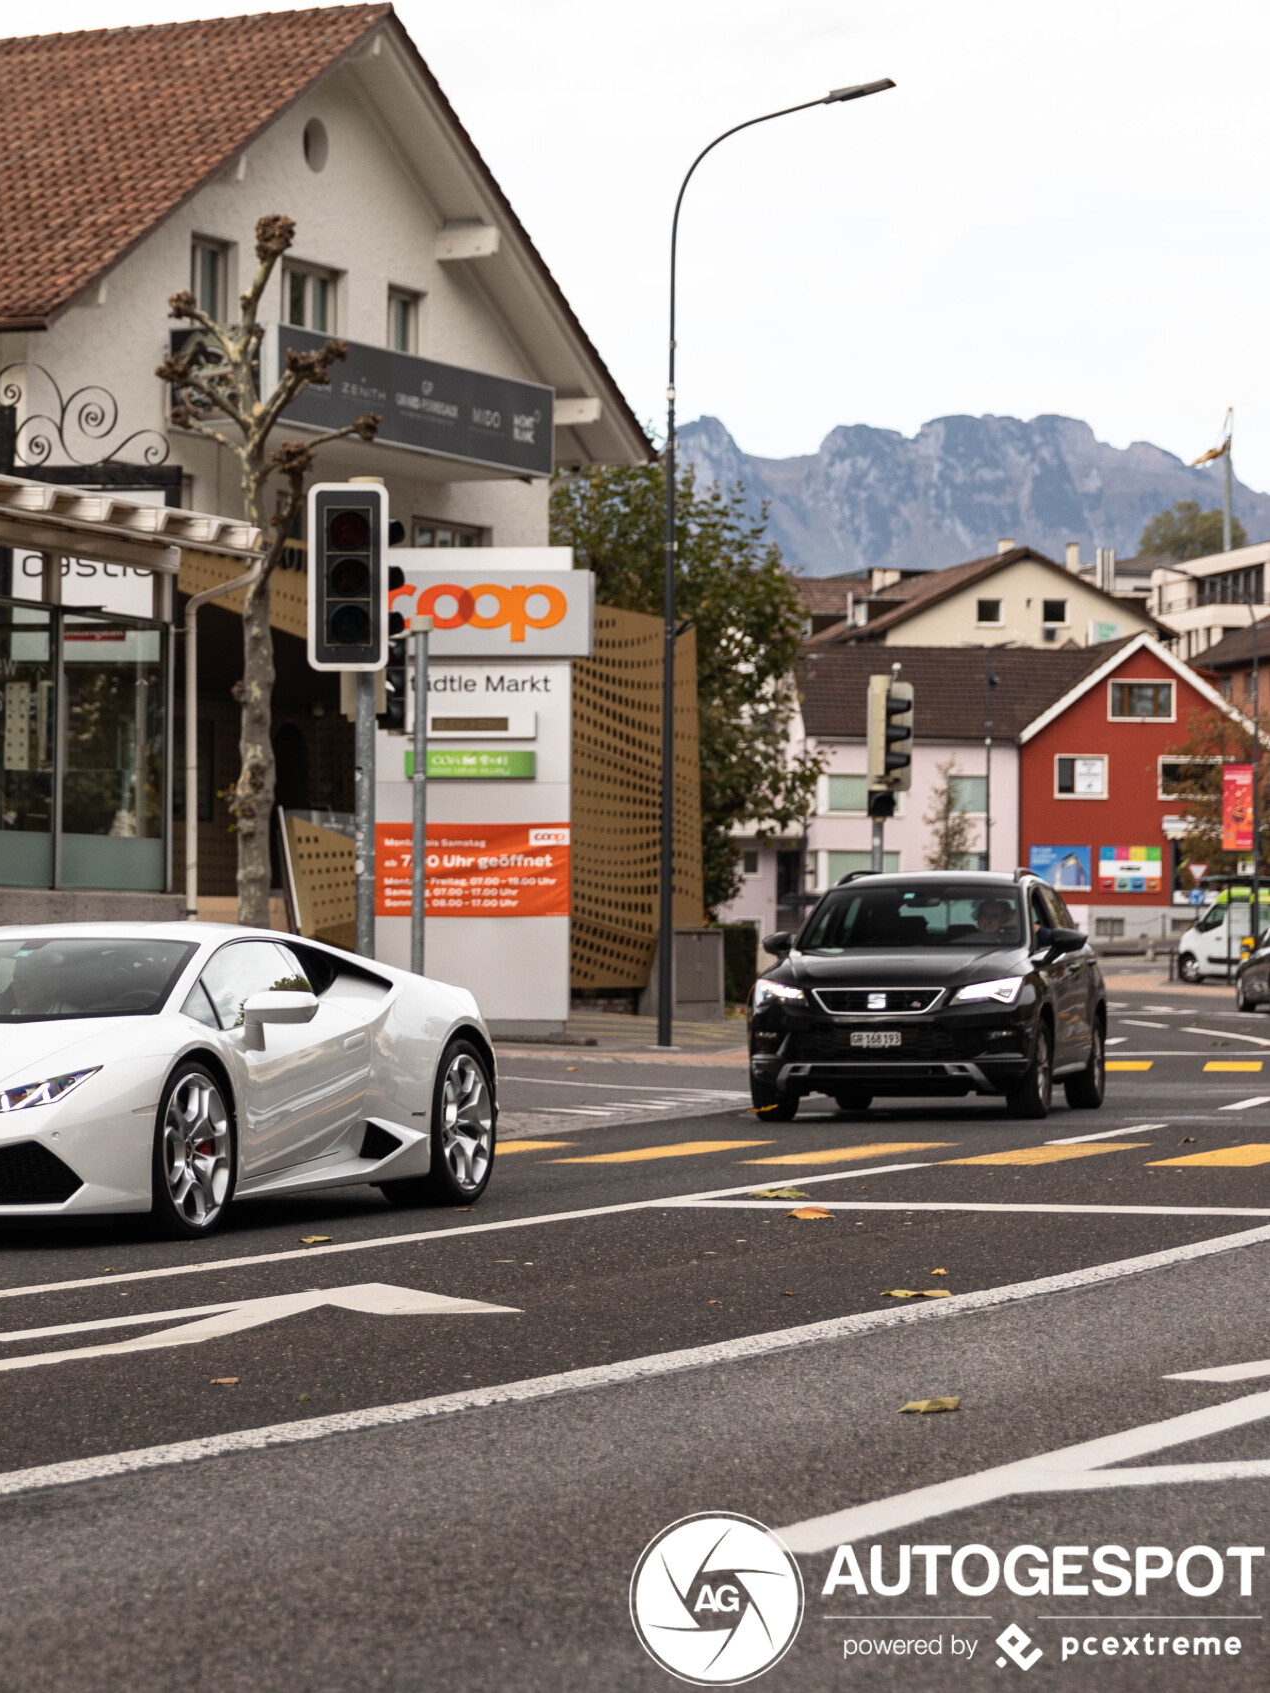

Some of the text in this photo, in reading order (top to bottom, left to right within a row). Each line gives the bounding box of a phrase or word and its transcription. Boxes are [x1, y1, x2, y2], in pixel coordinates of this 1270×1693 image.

[472, 407, 501, 429] MIDO
[485, 675, 551, 693] Markt
[441, 838, 486, 849] Samstag
[443, 854, 473, 868] Uhr
[477, 853, 553, 870] geöffnet
[538, 876, 557, 886] Uhr
[499, 887, 519, 896] Uhr
[499, 898, 519, 907] Uhr
